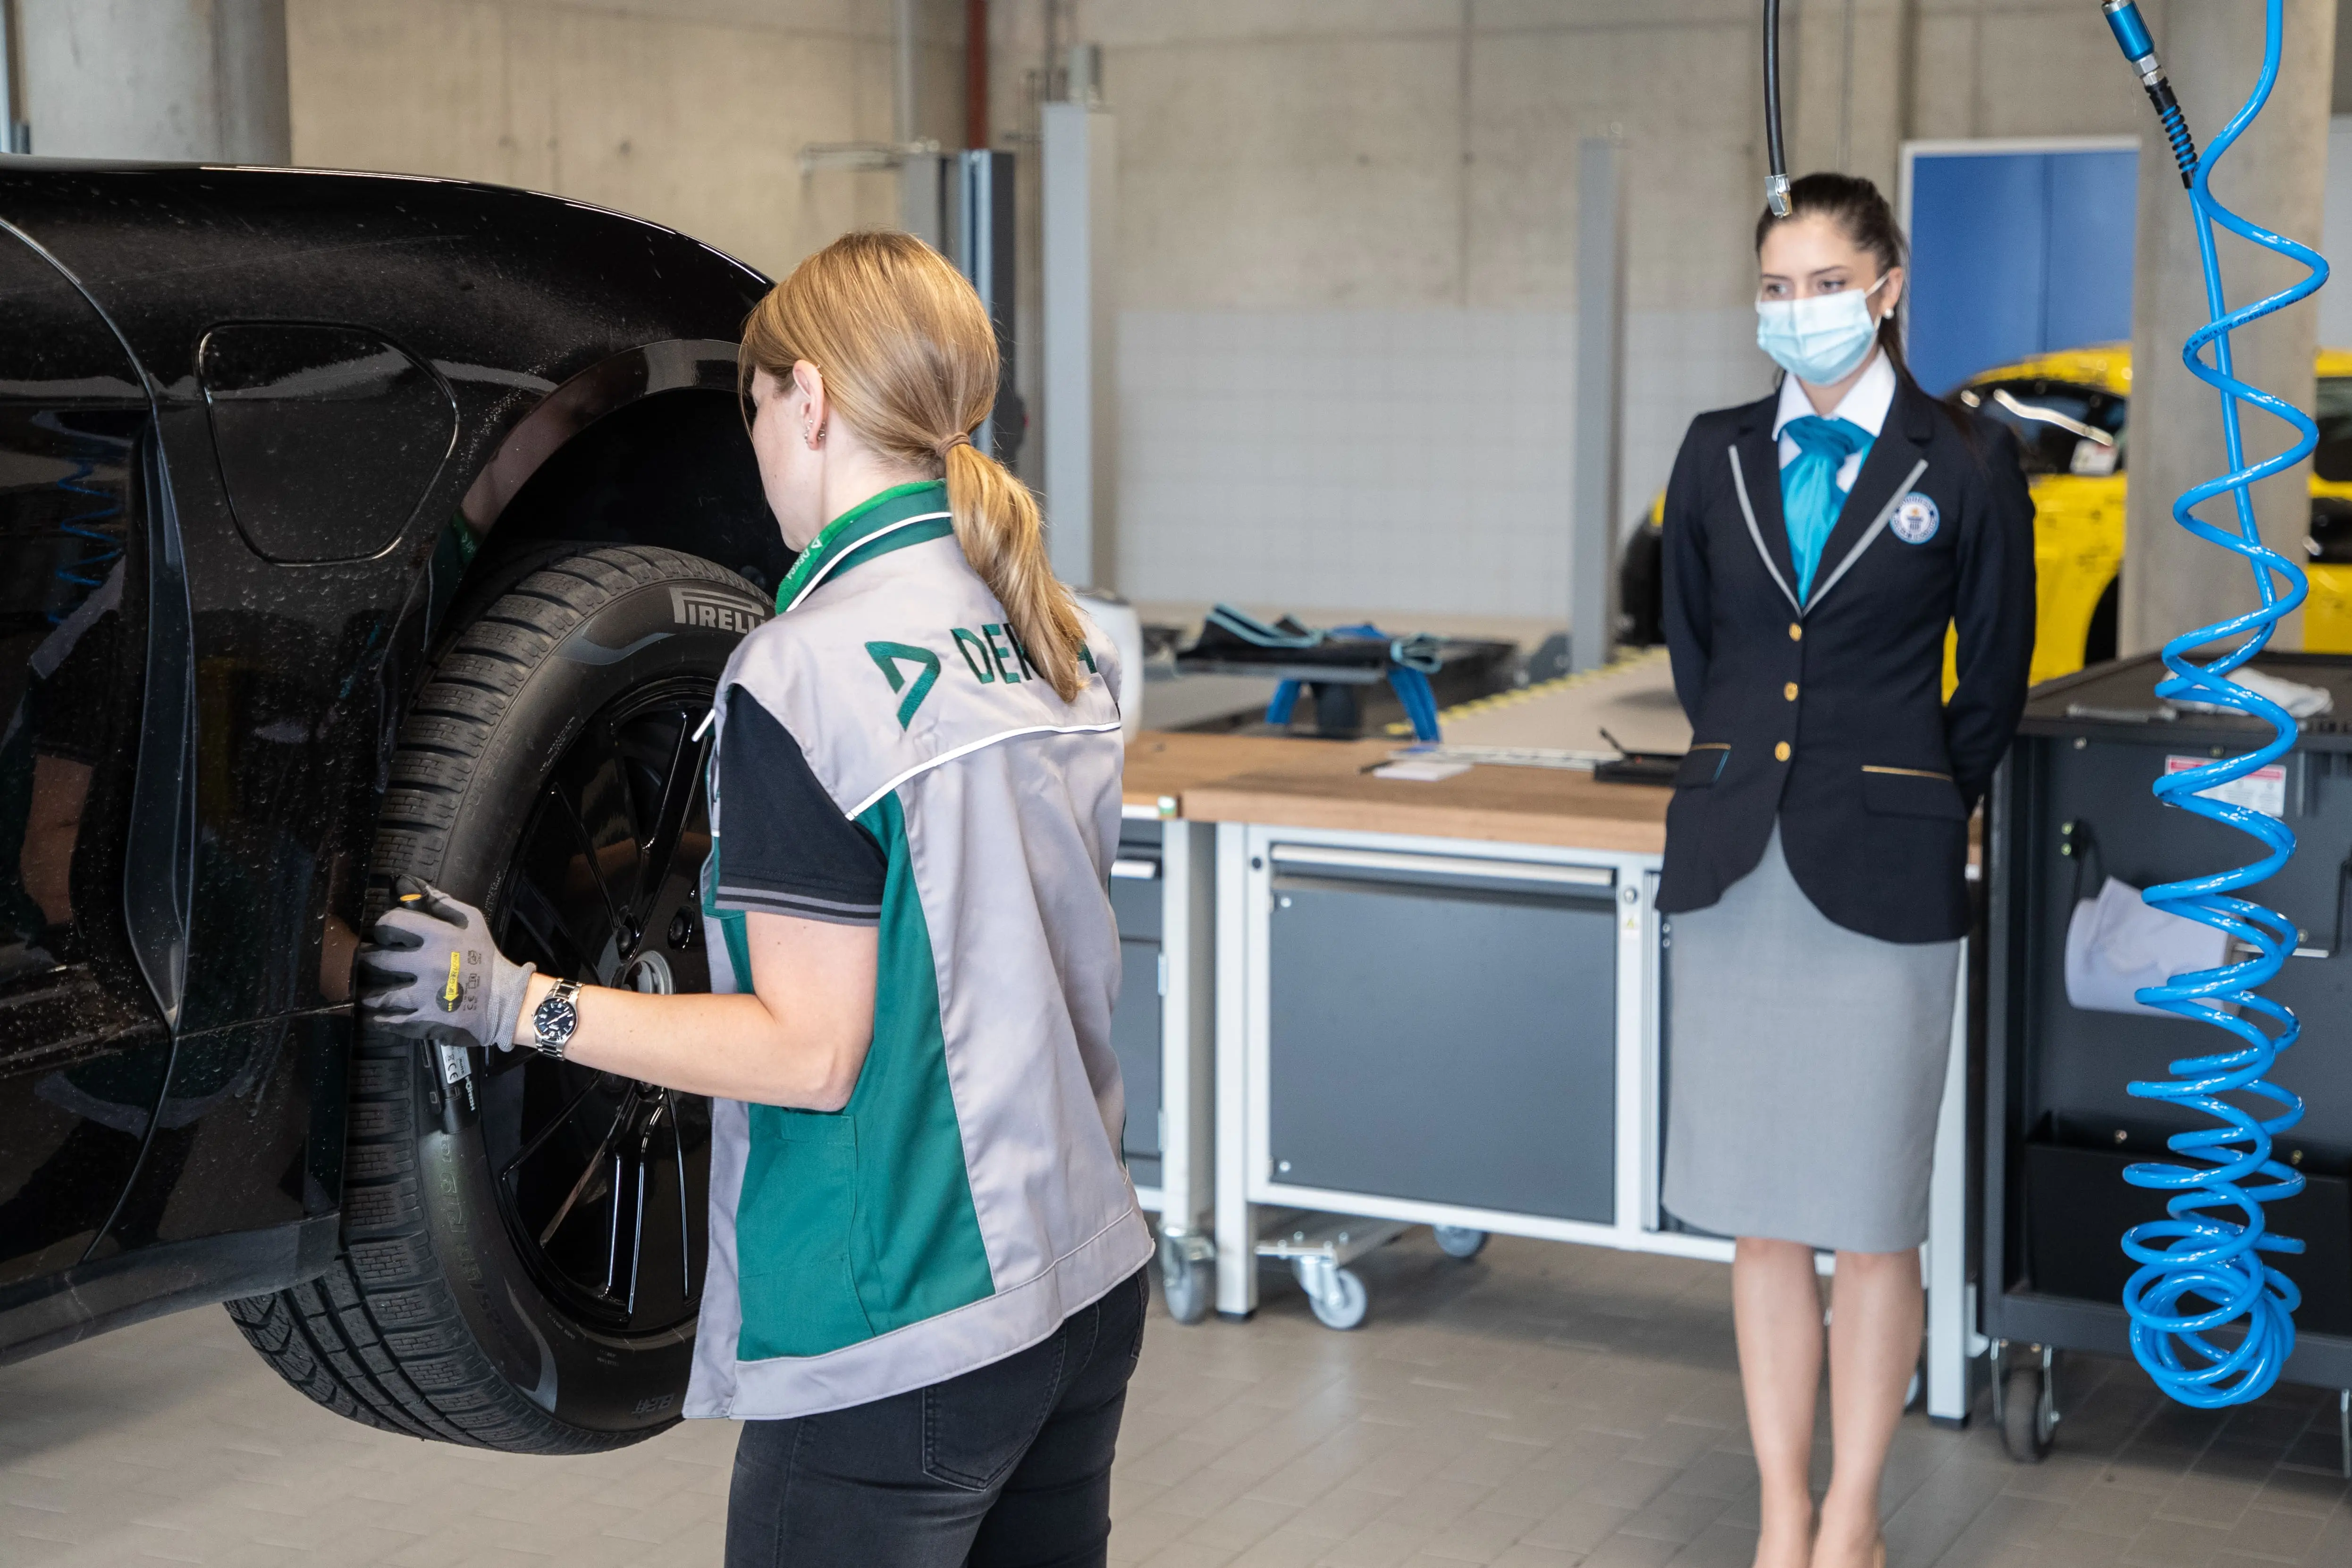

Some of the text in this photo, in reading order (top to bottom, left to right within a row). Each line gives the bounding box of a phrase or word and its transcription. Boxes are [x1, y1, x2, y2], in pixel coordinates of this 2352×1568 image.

[2200, 322, 2233, 341] Working
[2238, 305, 2280, 324] Pressure
[668, 586, 767, 634] PIRELL
